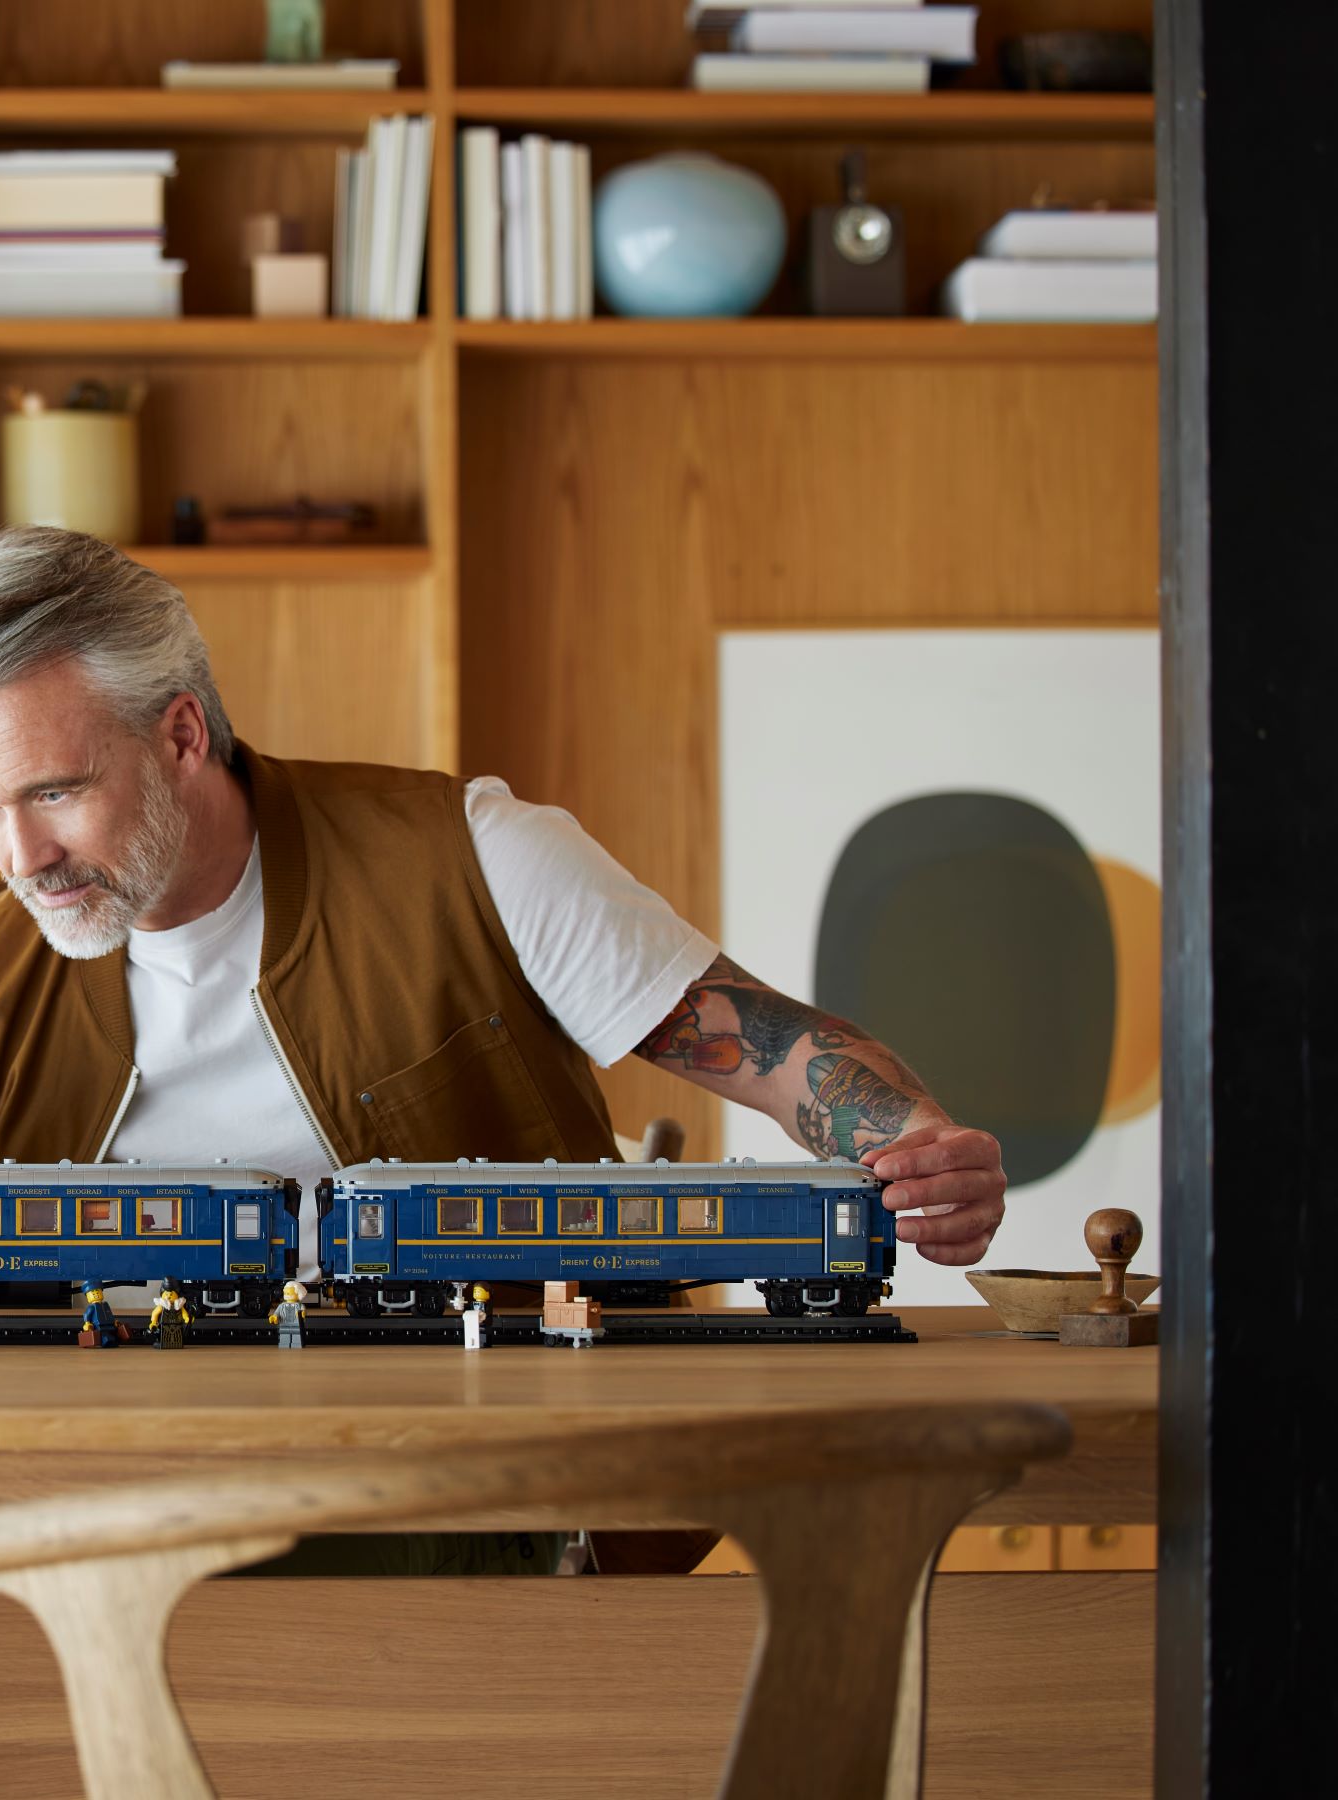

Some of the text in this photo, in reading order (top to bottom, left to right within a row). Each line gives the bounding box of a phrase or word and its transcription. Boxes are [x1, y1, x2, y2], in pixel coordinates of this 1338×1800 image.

[426, 1187, 449, 1195] PARIS
[518, 1187, 540, 1195] WIEN
[555, 1187, 595, 1195] BUDAPEST
